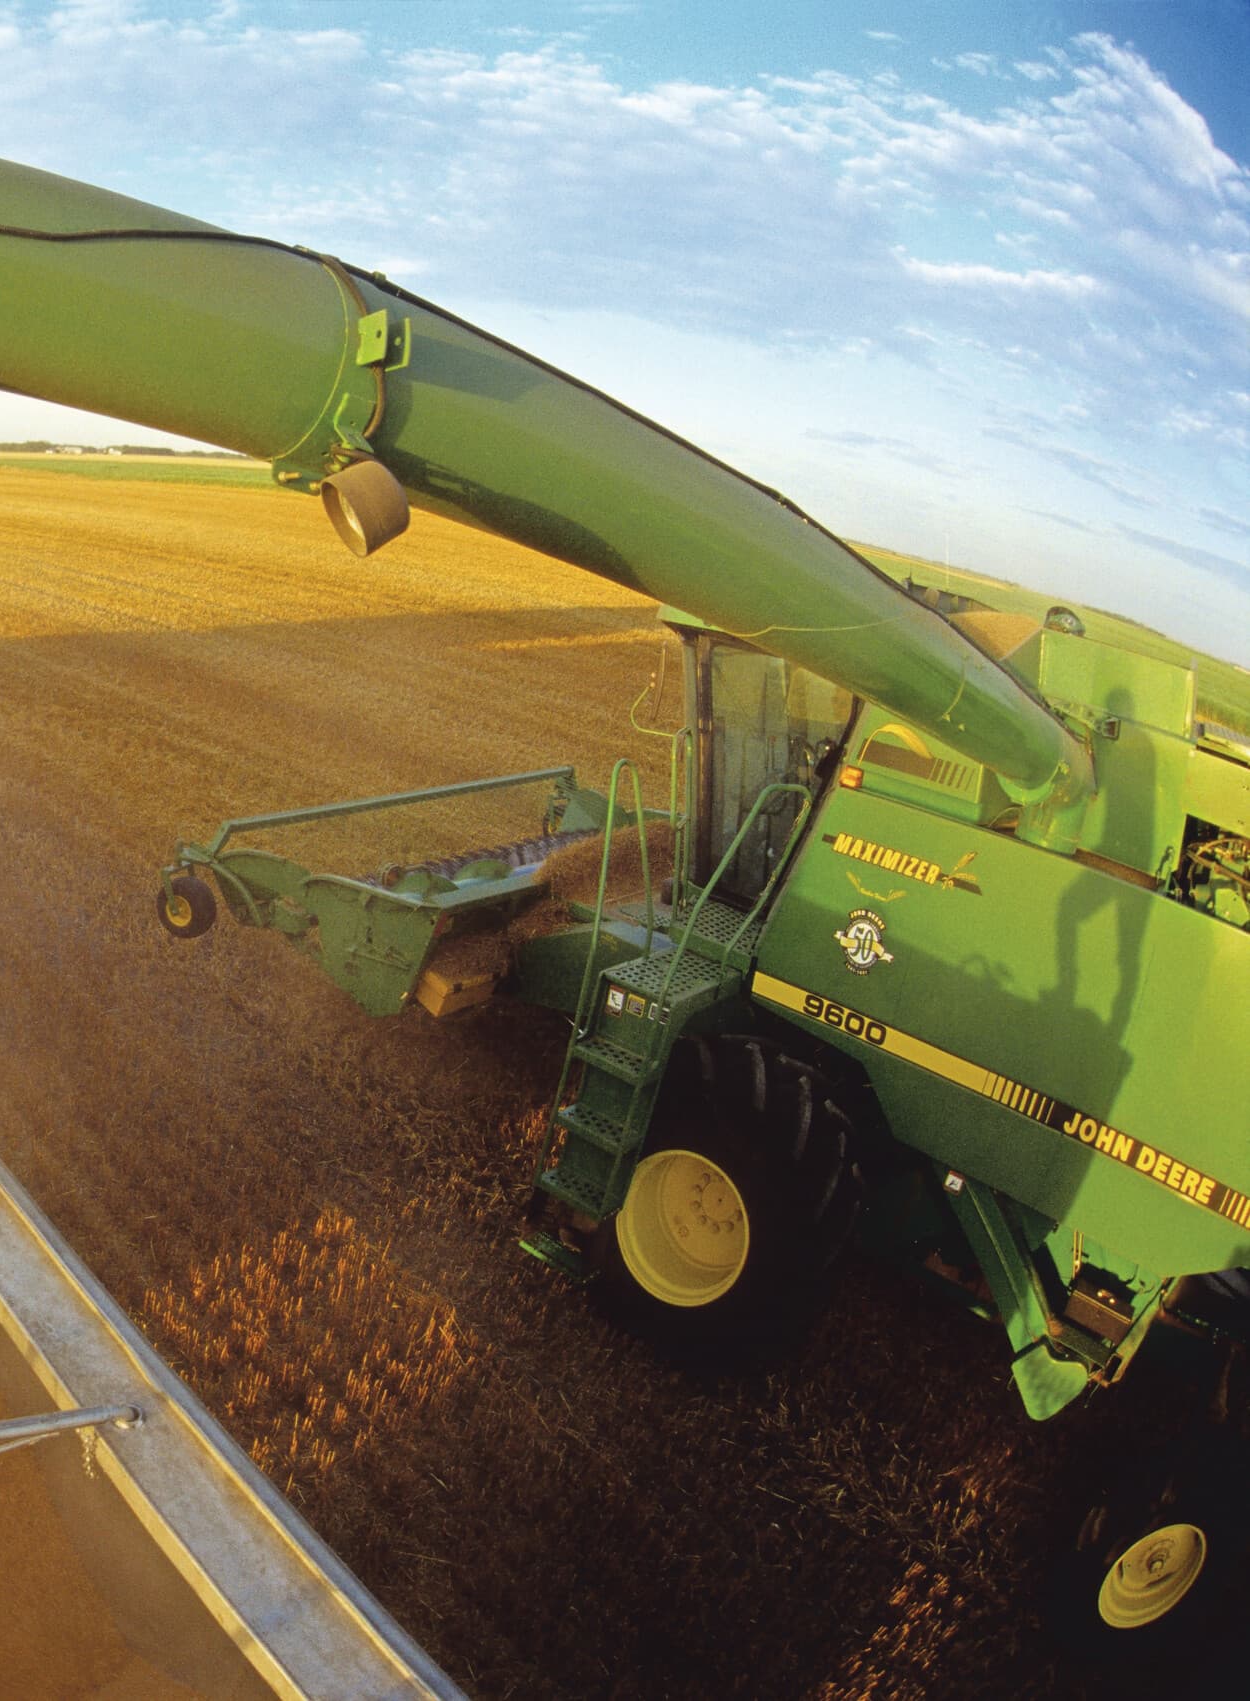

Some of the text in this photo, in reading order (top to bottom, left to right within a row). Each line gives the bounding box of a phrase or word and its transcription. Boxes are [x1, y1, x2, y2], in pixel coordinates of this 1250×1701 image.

[833, 832, 941, 885] MAXIMIZER
[850, 926, 873, 961] 50
[802, 994, 888, 1046] 9600
[1063, 1112, 1217, 1205] JOHN DEERE
